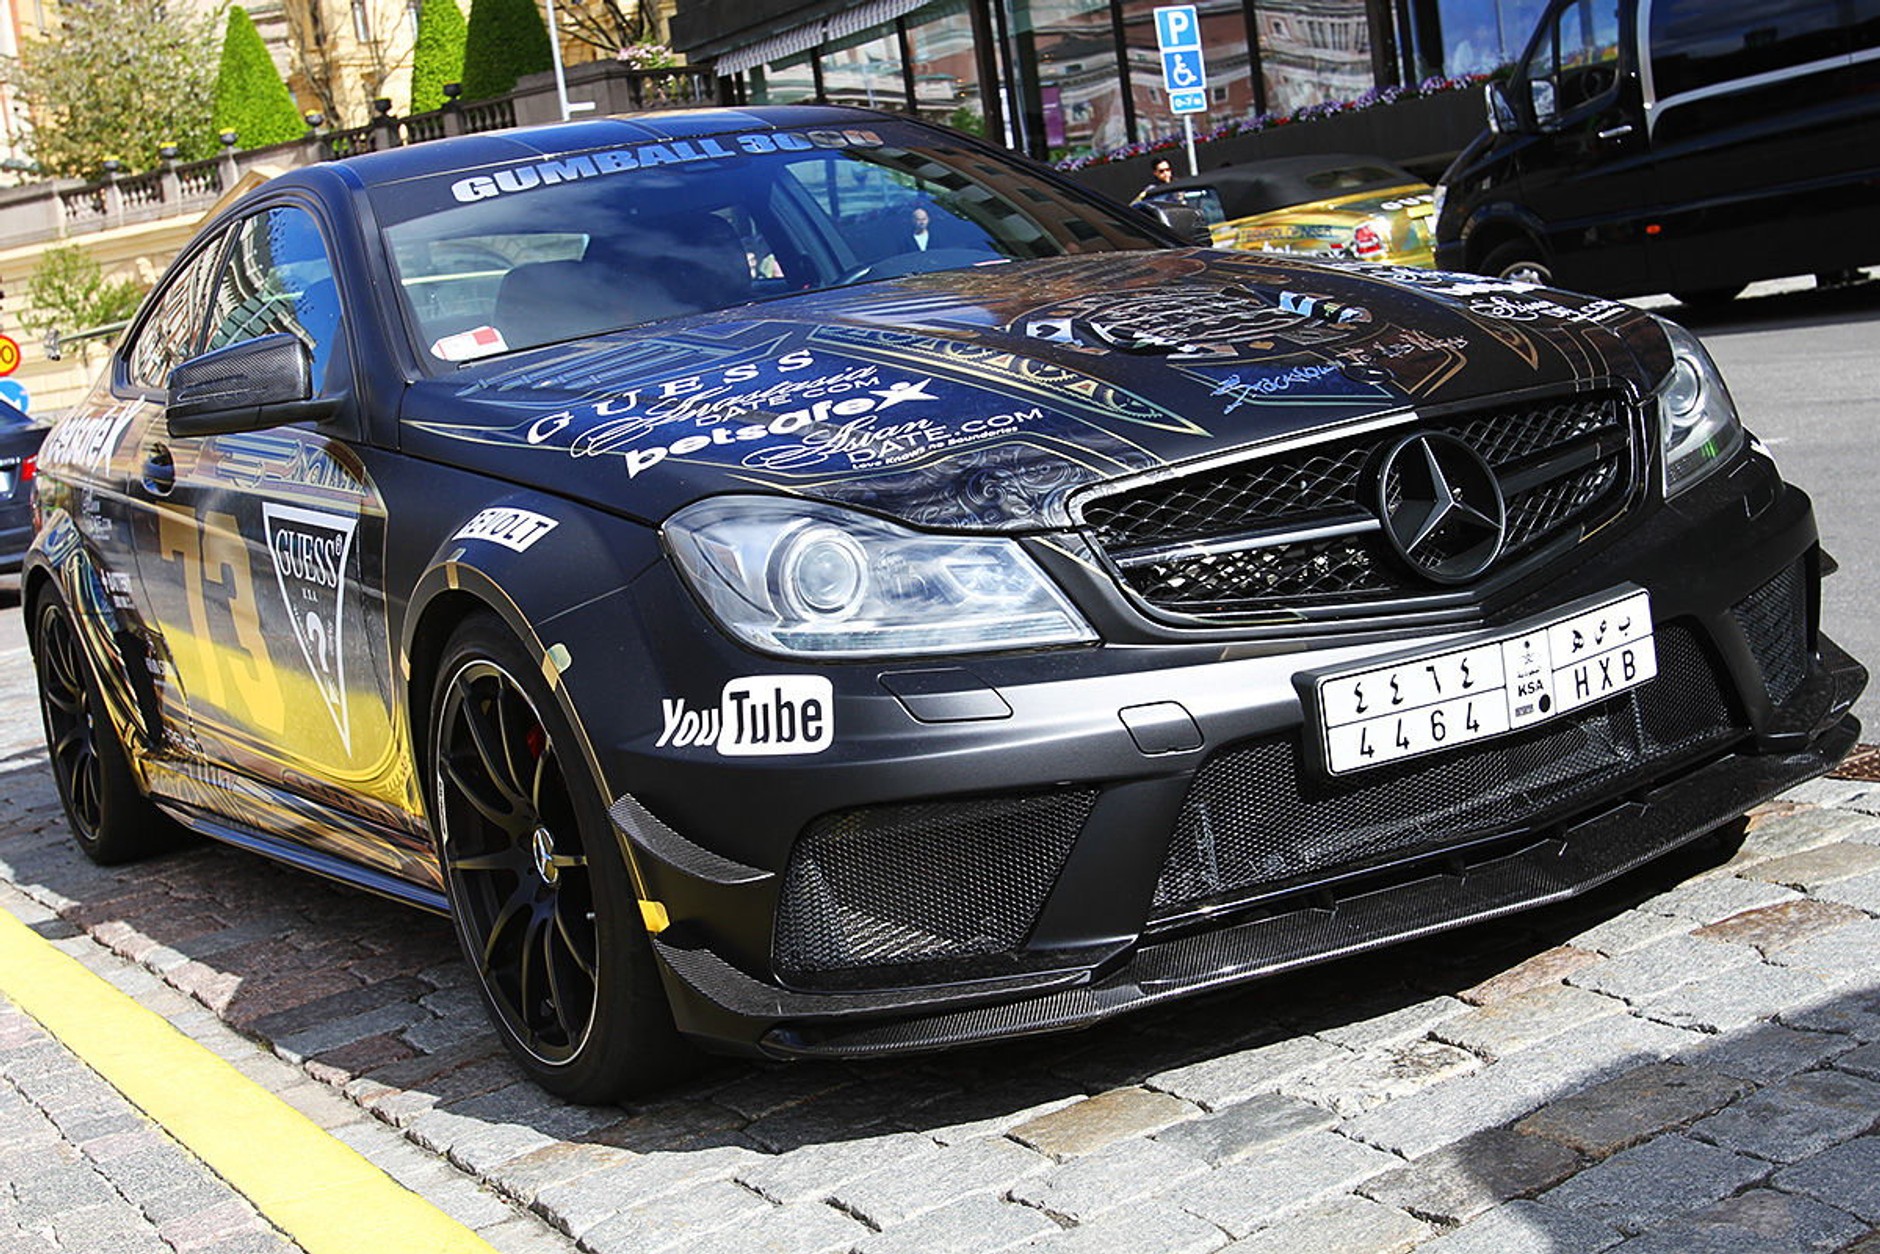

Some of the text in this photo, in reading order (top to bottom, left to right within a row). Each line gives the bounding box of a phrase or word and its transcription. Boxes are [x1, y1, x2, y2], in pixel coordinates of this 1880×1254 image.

[1167, 11, 1188, 45] P
[451, 130, 885, 203] GUMBALL 3000
[527, 349, 814, 444] GUESS
[156, 501, 285, 735] 73
[655, 687, 825, 748] YouTube
[1517, 679, 1545, 697] KSA
[1360, 702, 1480, 758] 4464
